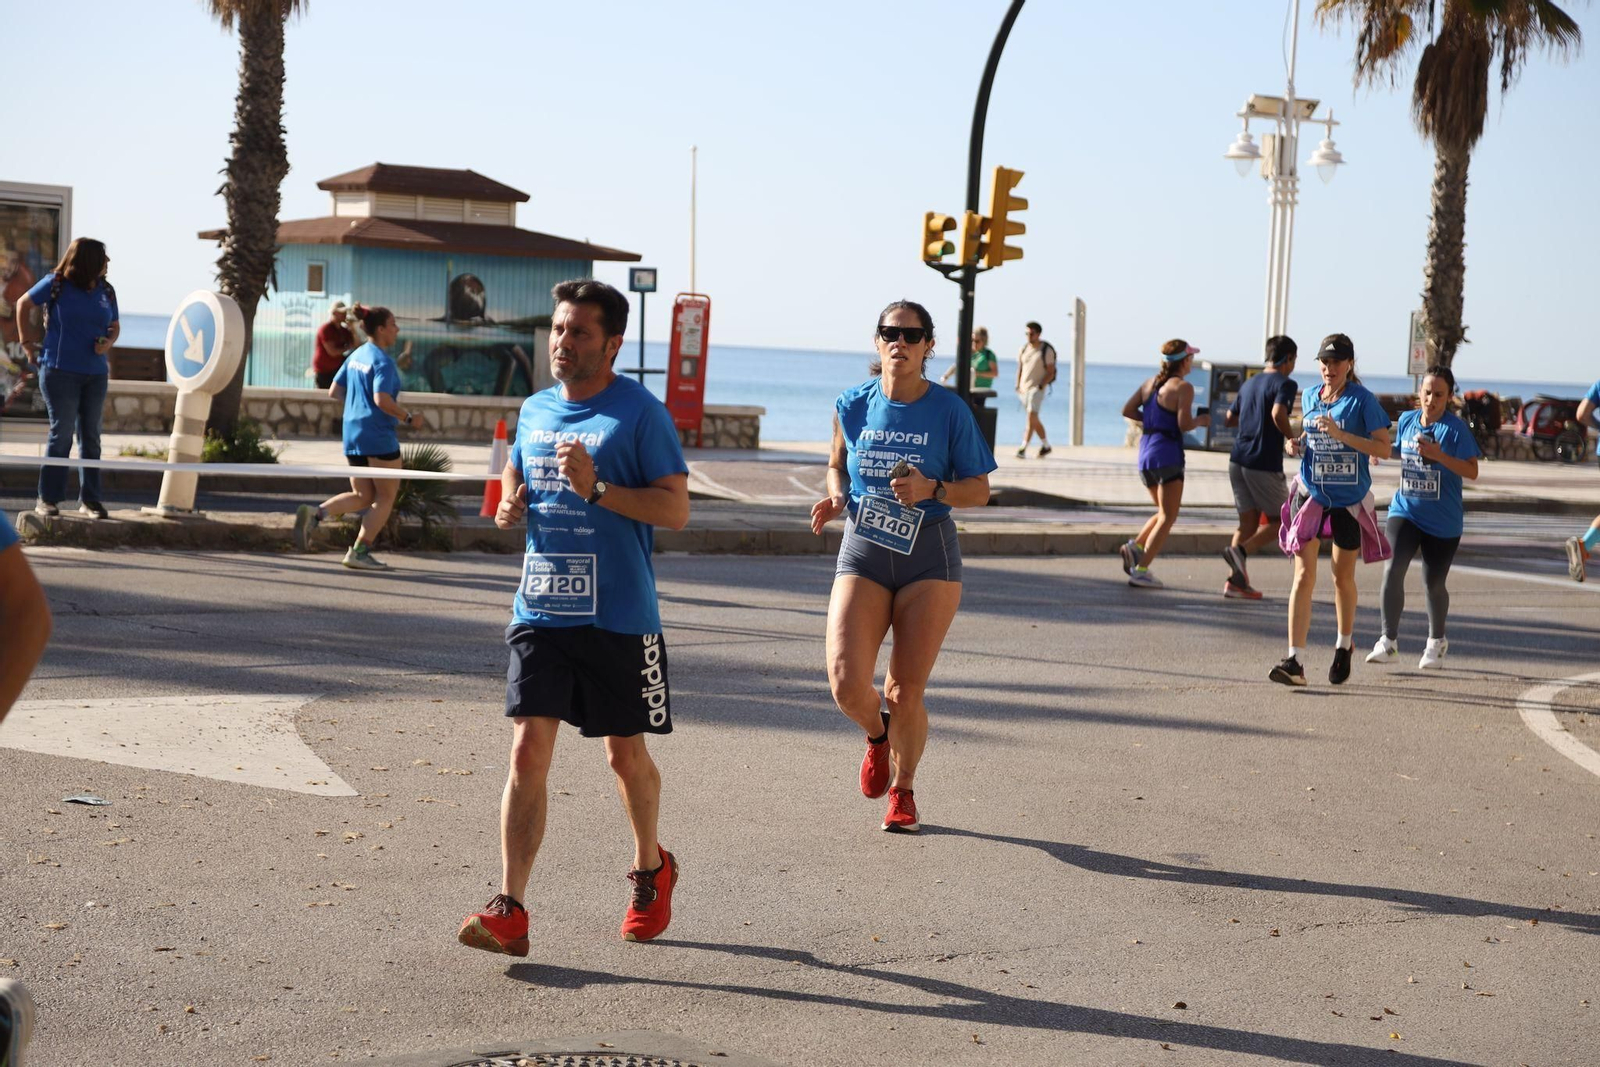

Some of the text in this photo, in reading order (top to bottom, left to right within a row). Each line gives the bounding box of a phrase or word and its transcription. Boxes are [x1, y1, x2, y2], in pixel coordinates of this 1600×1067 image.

[529, 429, 604, 448] mayoral
[859, 429, 929, 446] mayoral
[856, 449, 921, 464] RUNNING
[1318, 464, 1352, 473] 1921
[531, 480, 576, 493] FRIEN
[1406, 480, 1435, 490] 1858
[864, 510, 911, 537] 2140
[530, 576, 586, 594] 2120
[640, 634, 667, 728] adidas
